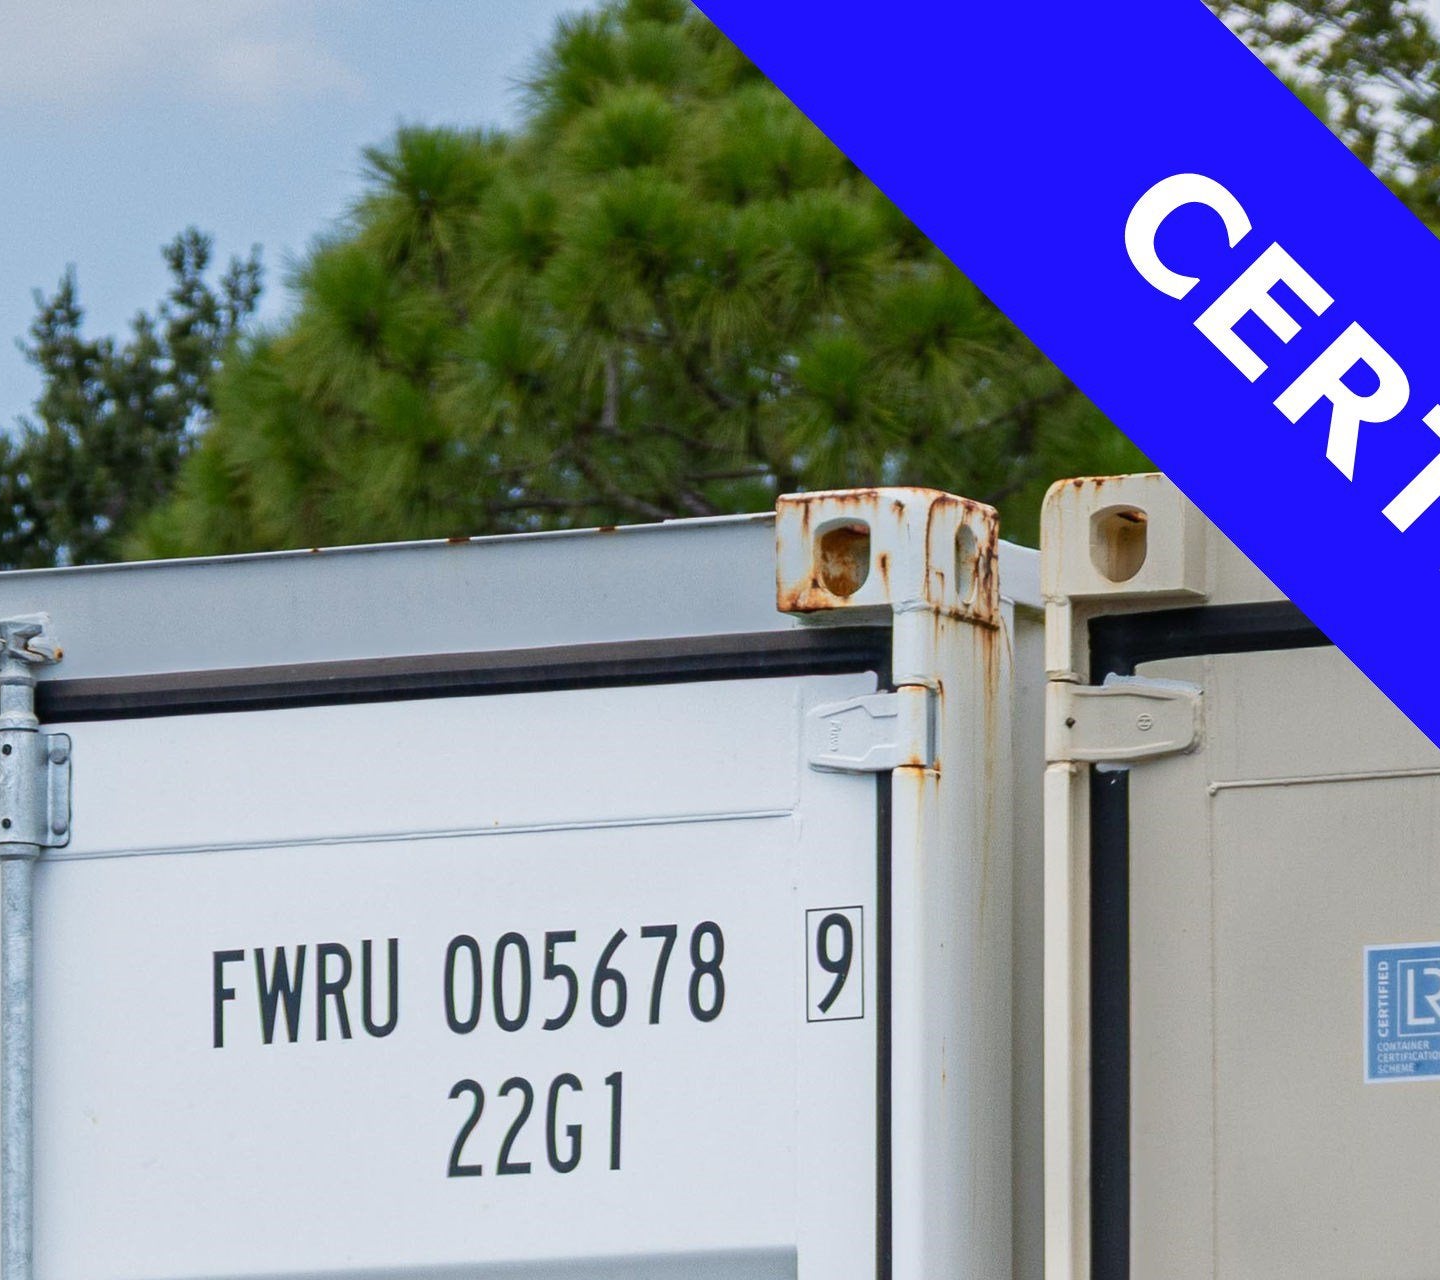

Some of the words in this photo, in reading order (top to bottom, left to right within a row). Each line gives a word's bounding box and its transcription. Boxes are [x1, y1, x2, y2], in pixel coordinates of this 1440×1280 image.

[212, 937, 399, 1049] FWRU
[443, 920, 725, 1036] 005678
[815, 913, 854, 1014] 9
[1377, 961, 1389, 1037] CERTIFIED
[1377, 1040, 1430, 1052] CONTAINER
[1377, 1062, 1416, 1073] SCHEME
[446, 1071, 623, 1178] 22G1
